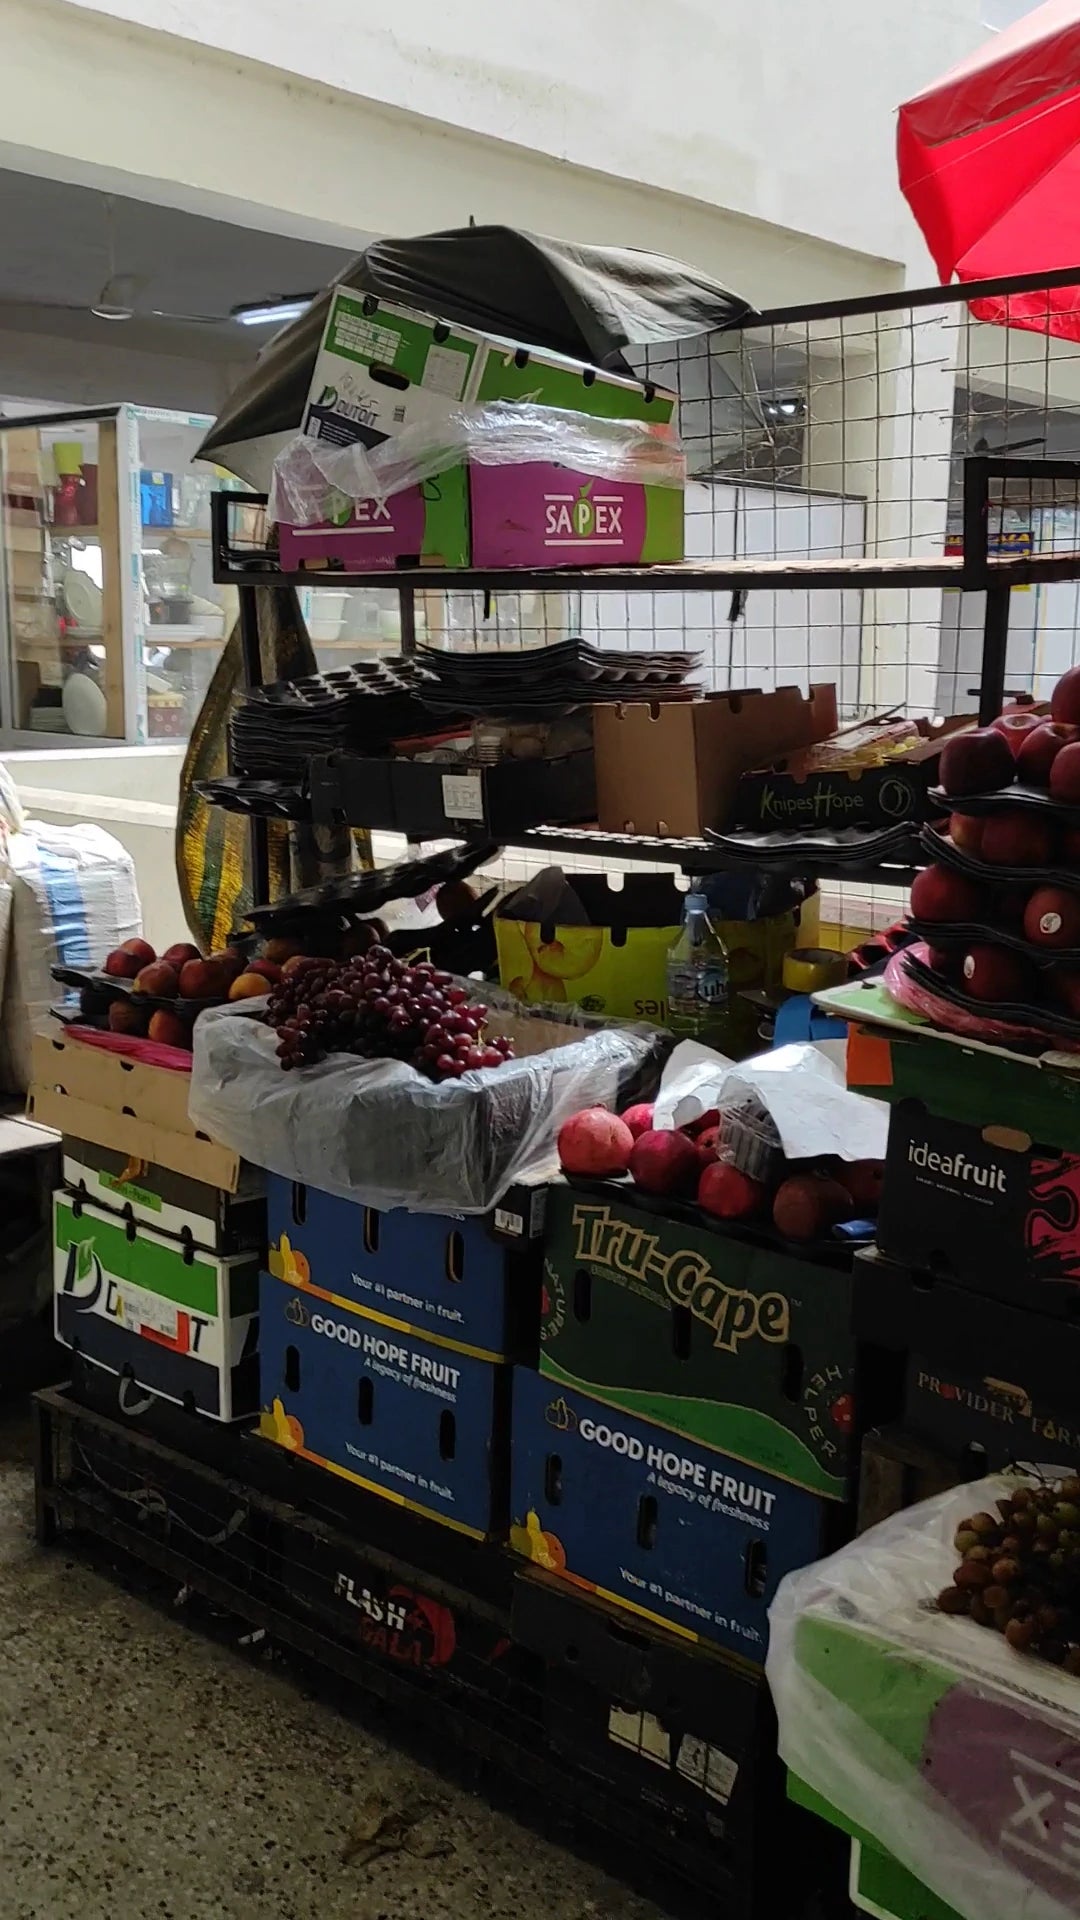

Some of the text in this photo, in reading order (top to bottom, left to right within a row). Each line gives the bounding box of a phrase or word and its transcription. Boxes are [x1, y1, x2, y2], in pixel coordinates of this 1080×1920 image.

[545, 503, 622, 534] SAPEX
[907, 1138, 1007, 1193] ideafruit
[351, 1272, 373, 1291] Your
[386, 1287, 423, 1309] partner
[425, 1300, 436, 1314] in
[571, 1203, 791, 1355] Tru-Cape
[311, 1314, 460, 1389] GOOD HOPE FRUIT
[363, 1357, 457, 1403] A legacy of freshness
[804, 1365, 843, 1458] HELPER
[344, 1440, 366, 1461] Your
[380, 1459, 416, 1485] partner
[417, 1473, 428, 1489] in
[578, 1418, 644, 1461] GOOD
[646, 1444, 707, 1488] HOPE
[710, 1469, 776, 1515] FRUIT
[646, 1472, 770, 1532] A legacy of freshness
[334, 1570, 407, 1632] FLASH
[618, 1565, 648, 1590] Your
[649, 1581, 663, 1597] #1
[664, 1590, 713, 1621] partner
[714, 1611, 728, 1628] in
